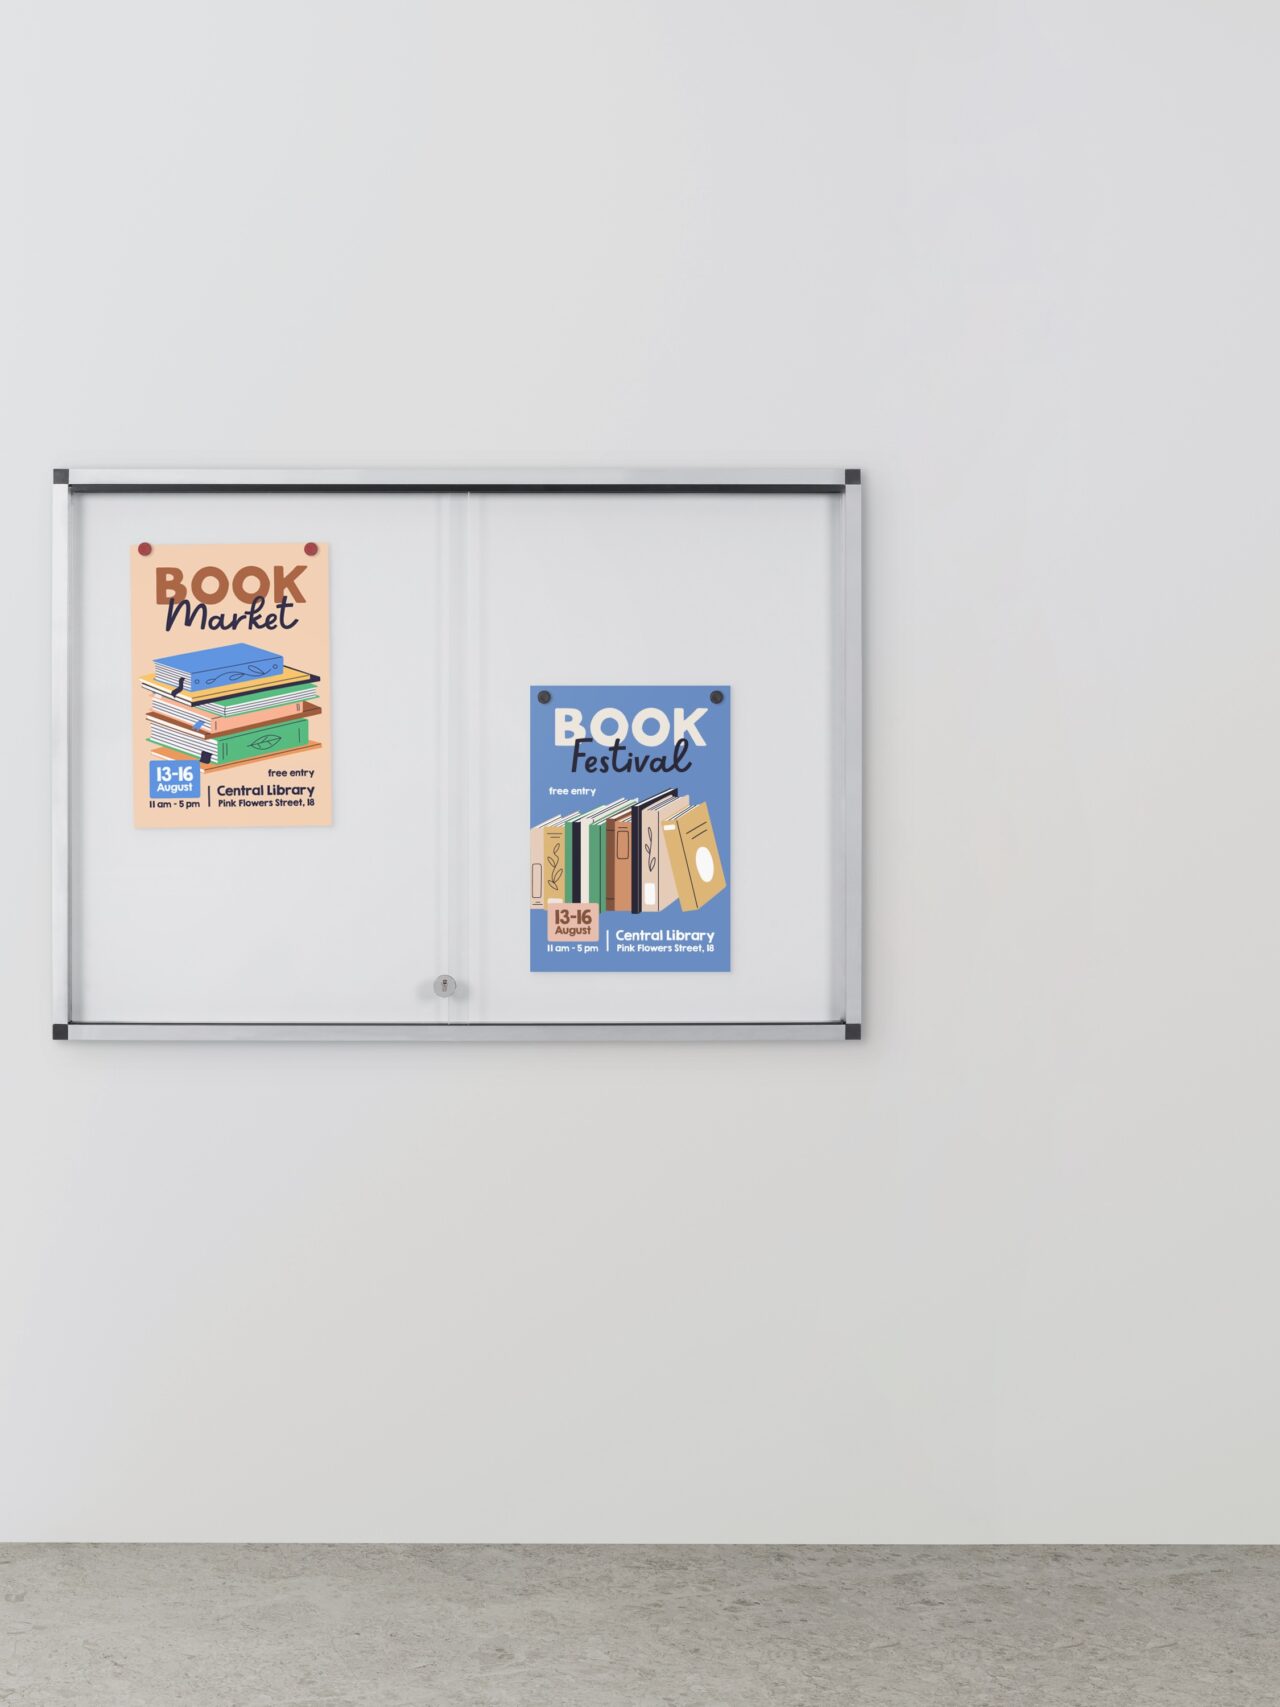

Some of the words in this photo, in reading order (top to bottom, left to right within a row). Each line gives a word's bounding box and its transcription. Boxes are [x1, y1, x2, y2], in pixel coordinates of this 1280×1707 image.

[155, 565, 308, 605] BOOK
[165, 595, 299, 632] Market
[554, 707, 708, 747] BOOK
[571, 738, 693, 773] Festival
[156, 766, 194, 782] 13-16
[268, 769, 287, 777] free
[289, 769, 315, 778] entry
[156, 782, 193, 794] August
[217, 785, 264, 796] Central
[267, 784, 315, 798] Library
[549, 786, 569, 796] free
[570, 786, 597, 797] entry
[149, 800, 156, 808] 11
[179, 800, 185, 808] 5
[186, 801, 200, 809] pm
[218, 799, 236, 807] Pink
[238, 798, 273, 807] Flowers
[275, 798, 305, 807] Street,
[307, 798, 315, 806] 18
[554, 909, 593, 925] 13-16
[554, 925, 592, 937] August
[615, 929, 663, 941] Central
[666, 929, 715, 944] Library
[547, 944, 554, 952] 11
[577, 944, 583, 952] 5
[584, 945, 599, 954] pm
[616, 944, 635, 952] Pink
[637, 944, 673, 952] Flowers
[674, 944, 705, 953] Street,
[706, 944, 715, 952] 18
